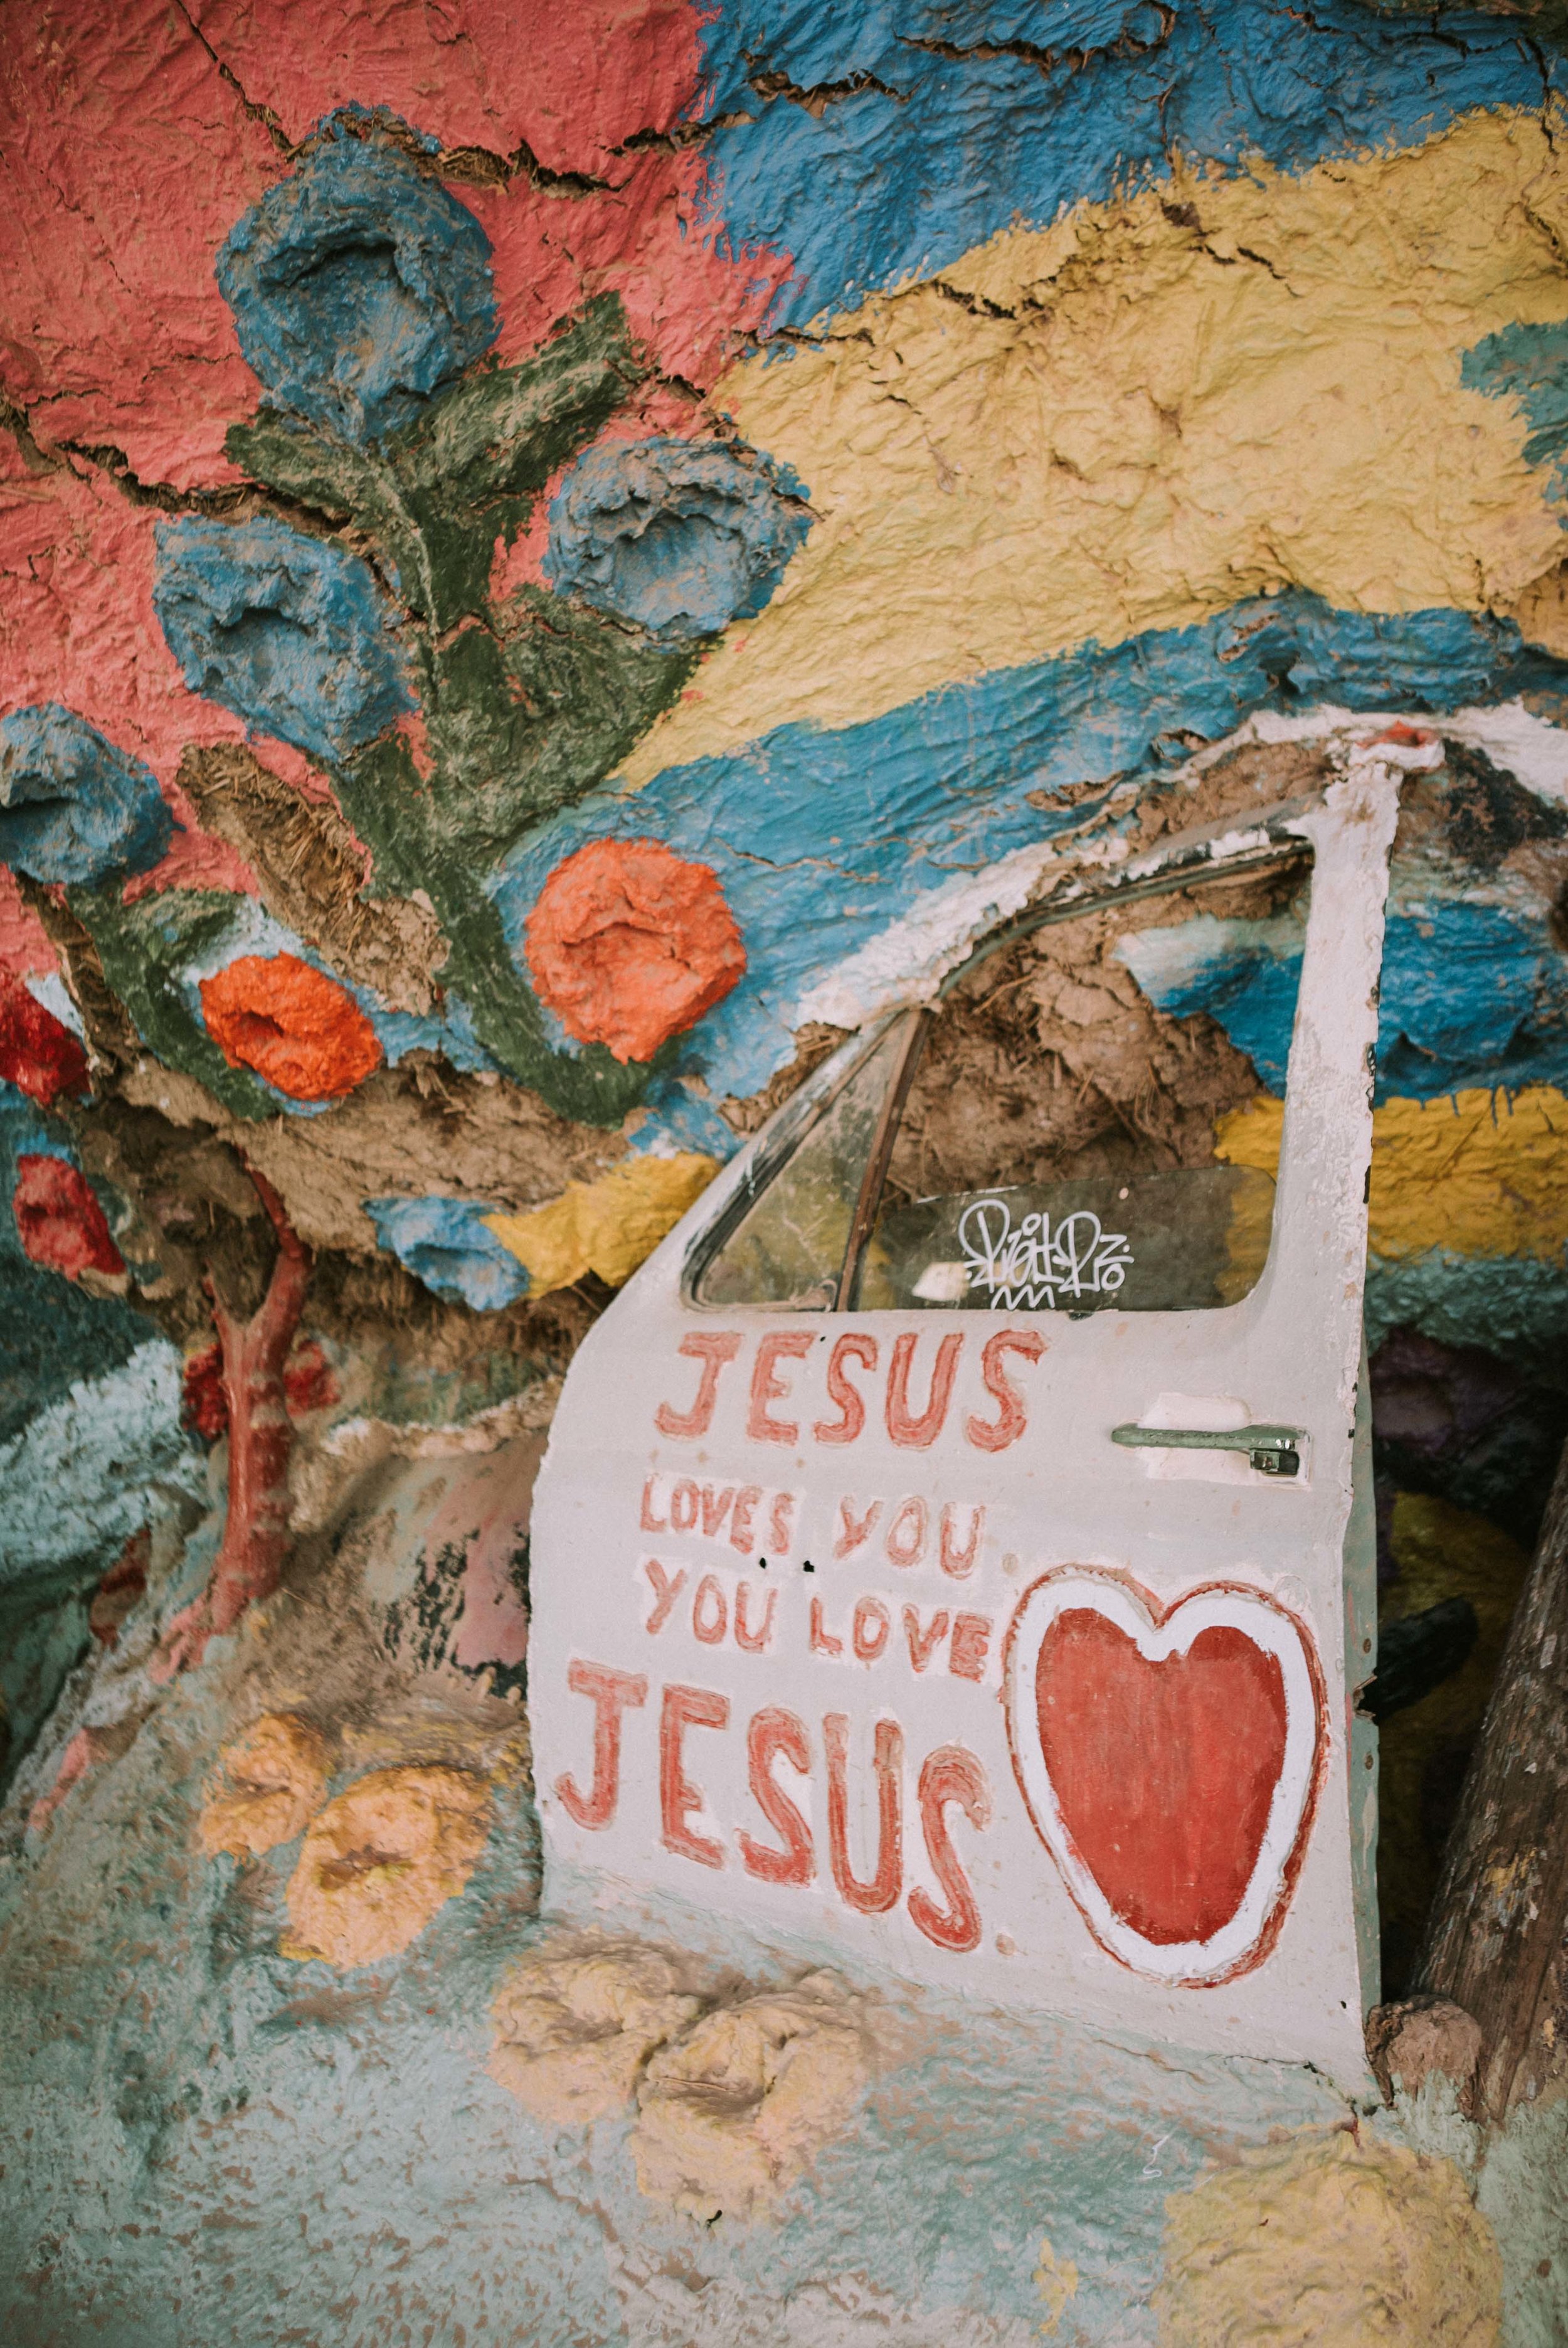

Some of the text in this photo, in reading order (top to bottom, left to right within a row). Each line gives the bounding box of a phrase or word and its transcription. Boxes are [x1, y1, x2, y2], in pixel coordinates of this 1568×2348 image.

[654, 1328, 1049, 1452] JESUS
[640, 1472, 985, 1580] LOVES YOU
[645, 1558, 994, 1683] YOU LOVE
[555, 1657, 992, 1953] JESUS
